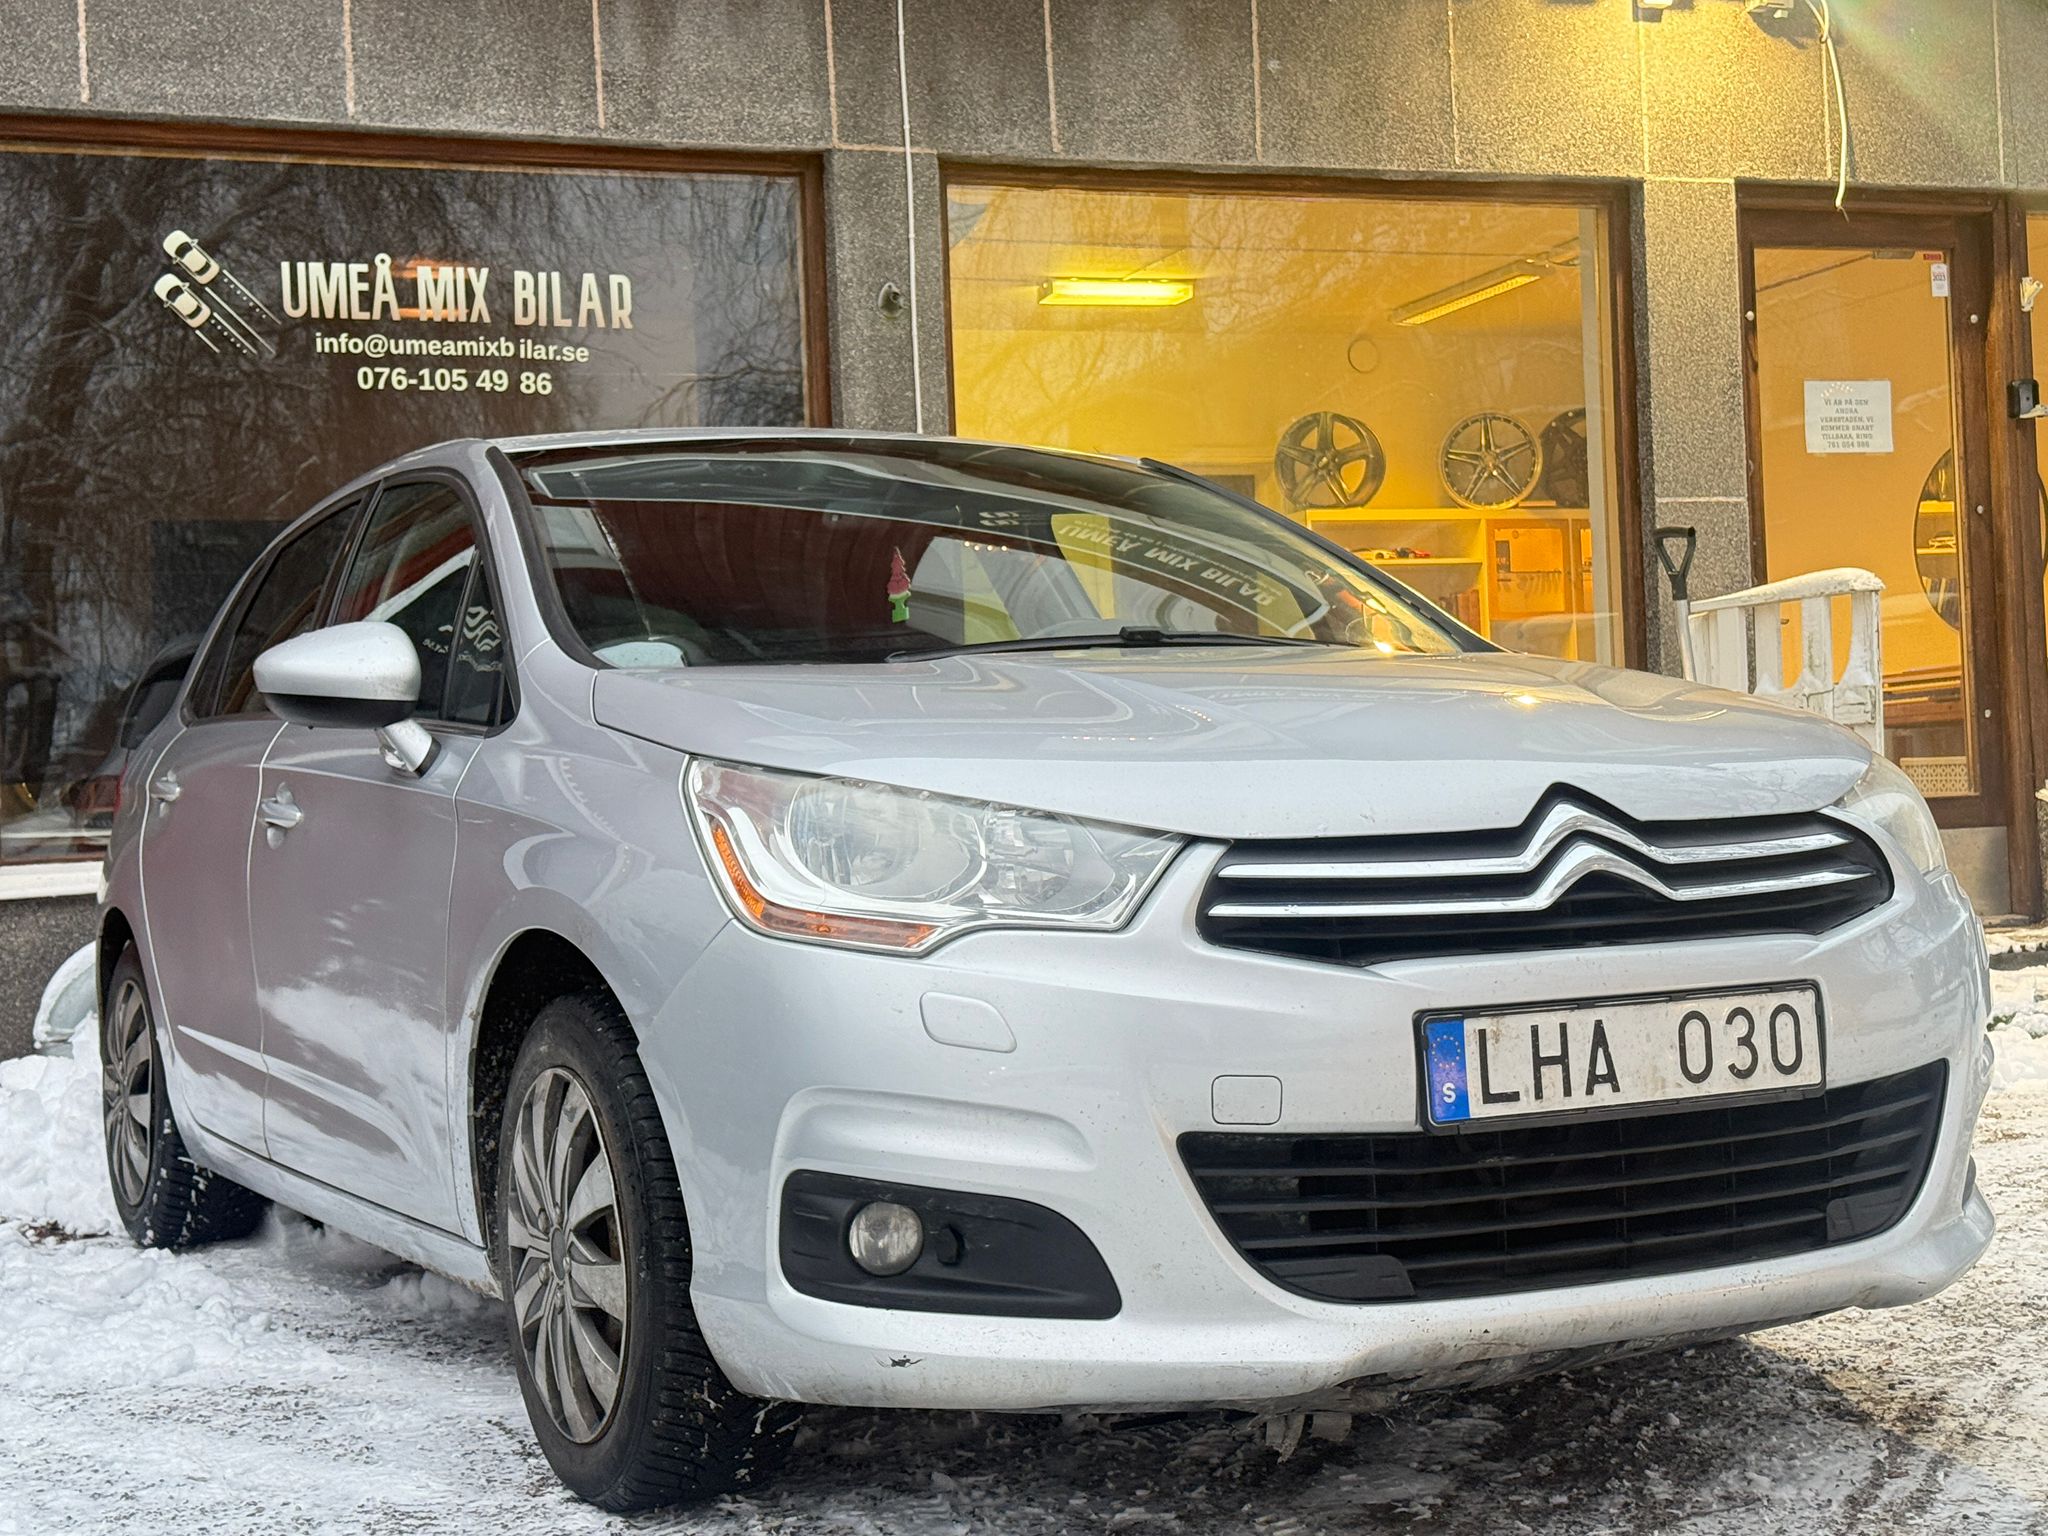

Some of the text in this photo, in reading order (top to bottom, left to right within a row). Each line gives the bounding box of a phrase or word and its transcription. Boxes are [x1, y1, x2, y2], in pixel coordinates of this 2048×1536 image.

[281, 253, 634, 329] UMEÅ MIX BILAR
[357, 367, 553, 395] 076-105 49 86
[1477, 1002, 1803, 1105] LHA 030
[1442, 1082, 1456, 1104] S
